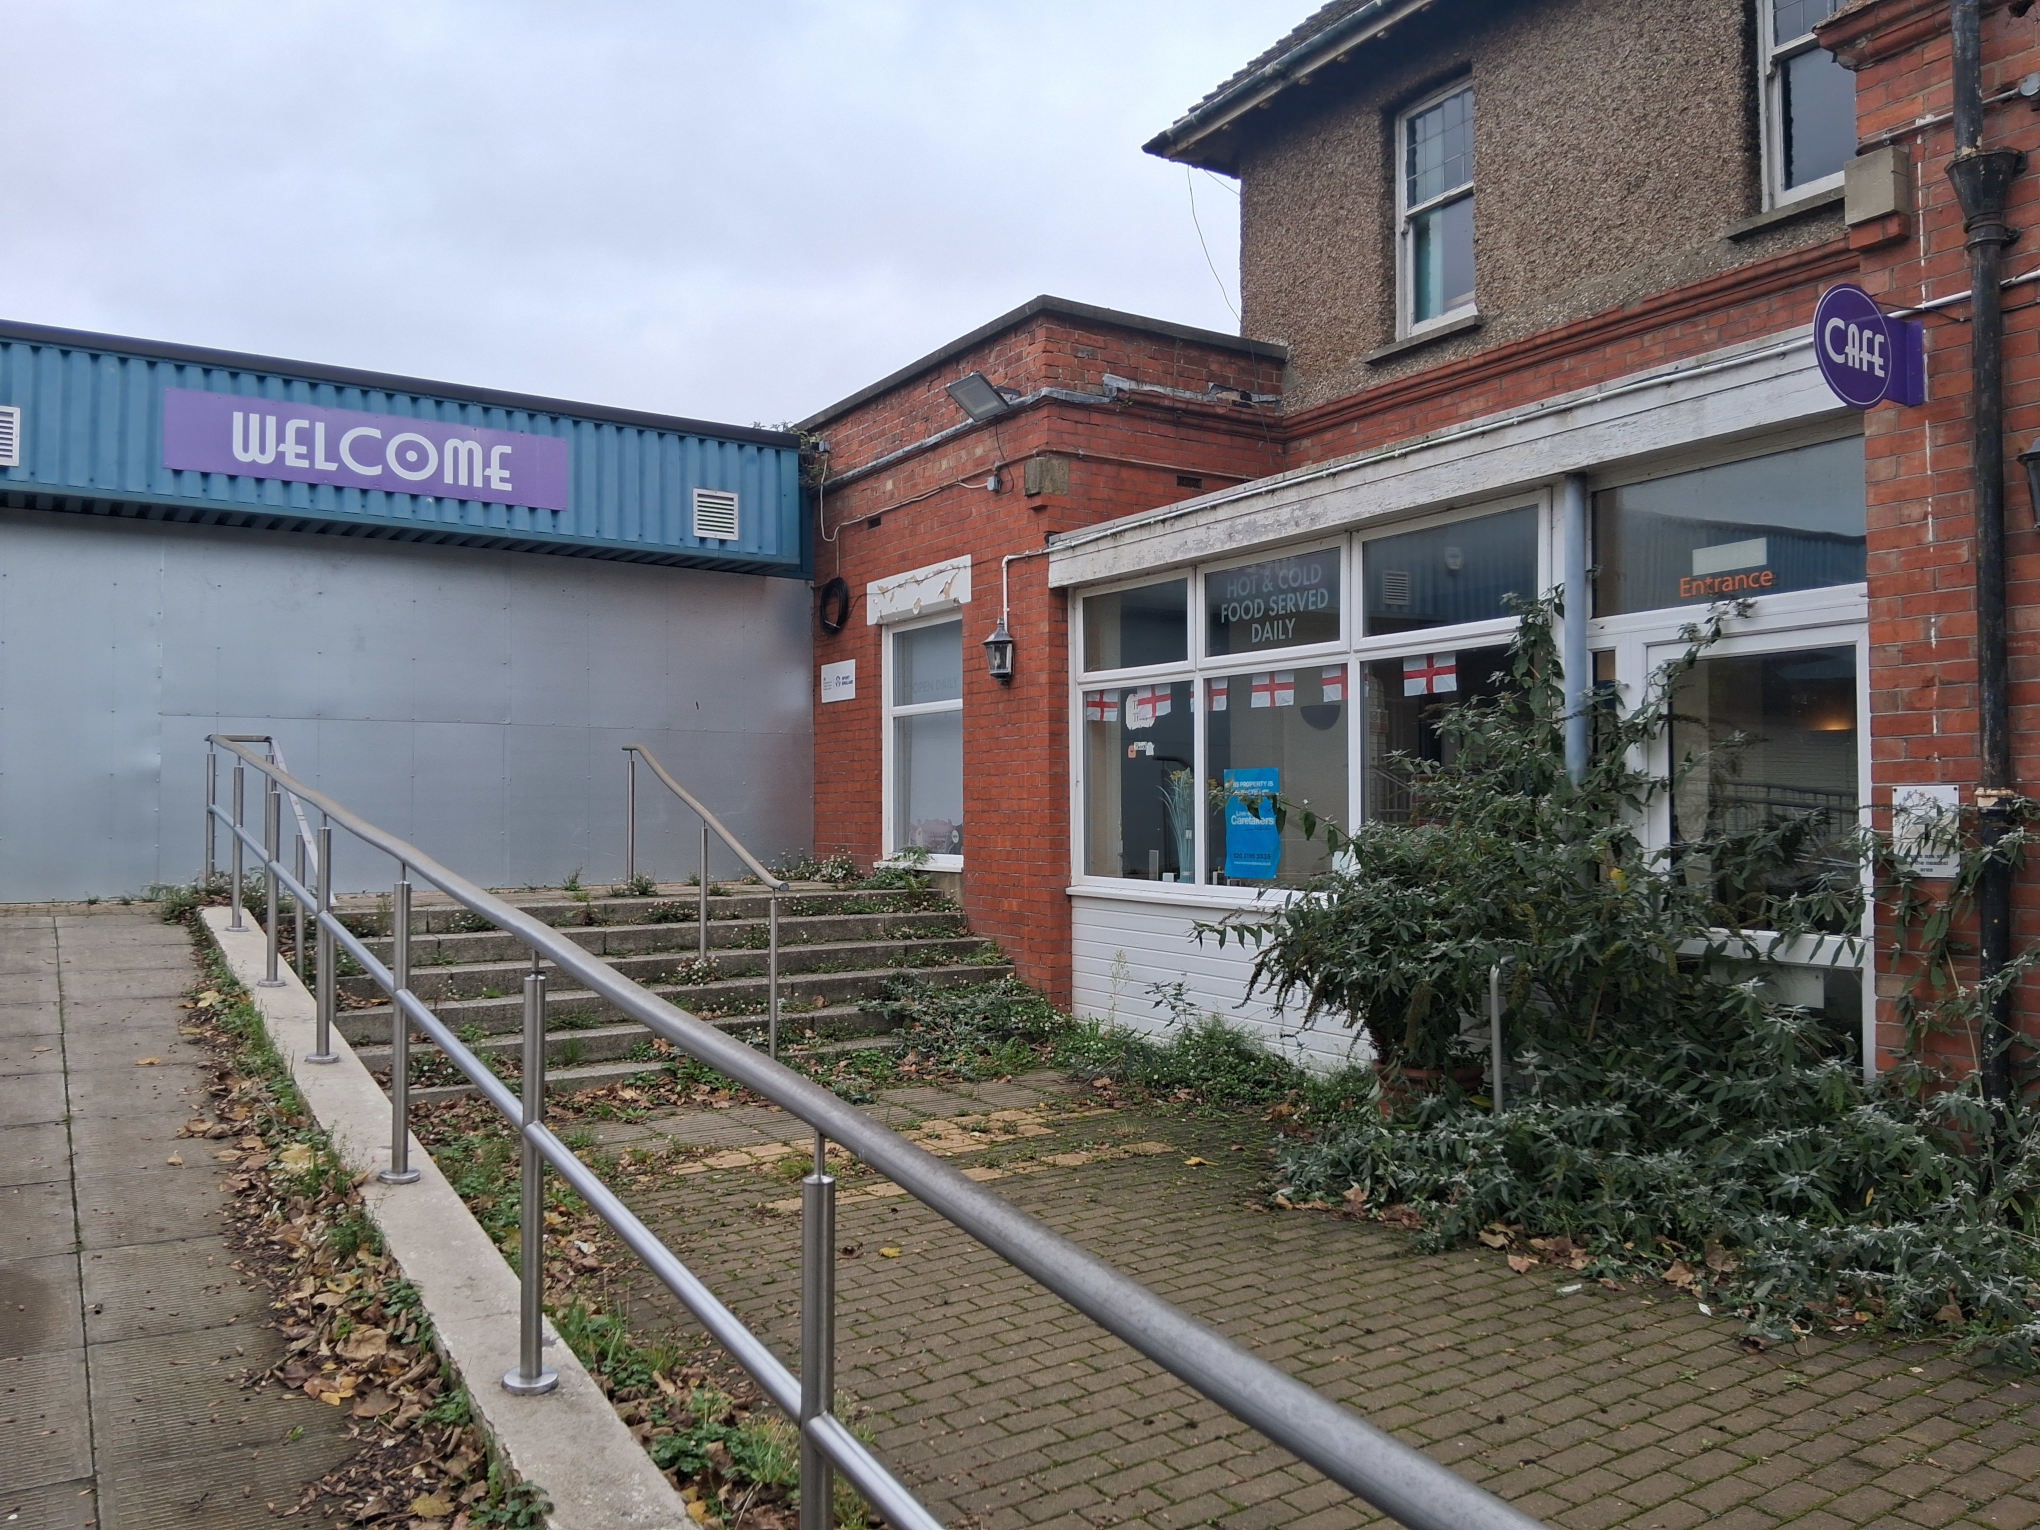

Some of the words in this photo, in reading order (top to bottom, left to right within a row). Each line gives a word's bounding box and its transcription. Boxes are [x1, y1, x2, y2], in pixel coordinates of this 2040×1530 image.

[1825, 317, 1885, 377] CAFE
[232, 411, 513, 492] WELCOME
[1227, 576, 1258, 598] HOT
[1262, 571, 1274, 593] &
[1278, 564, 1322, 590] COLD
[1679, 570, 1774, 598] Entrance
[1221, 599, 1265, 624] FOOD
[1269, 588, 1329, 617] SERVED
[1251, 618, 1296, 643] DAILY
